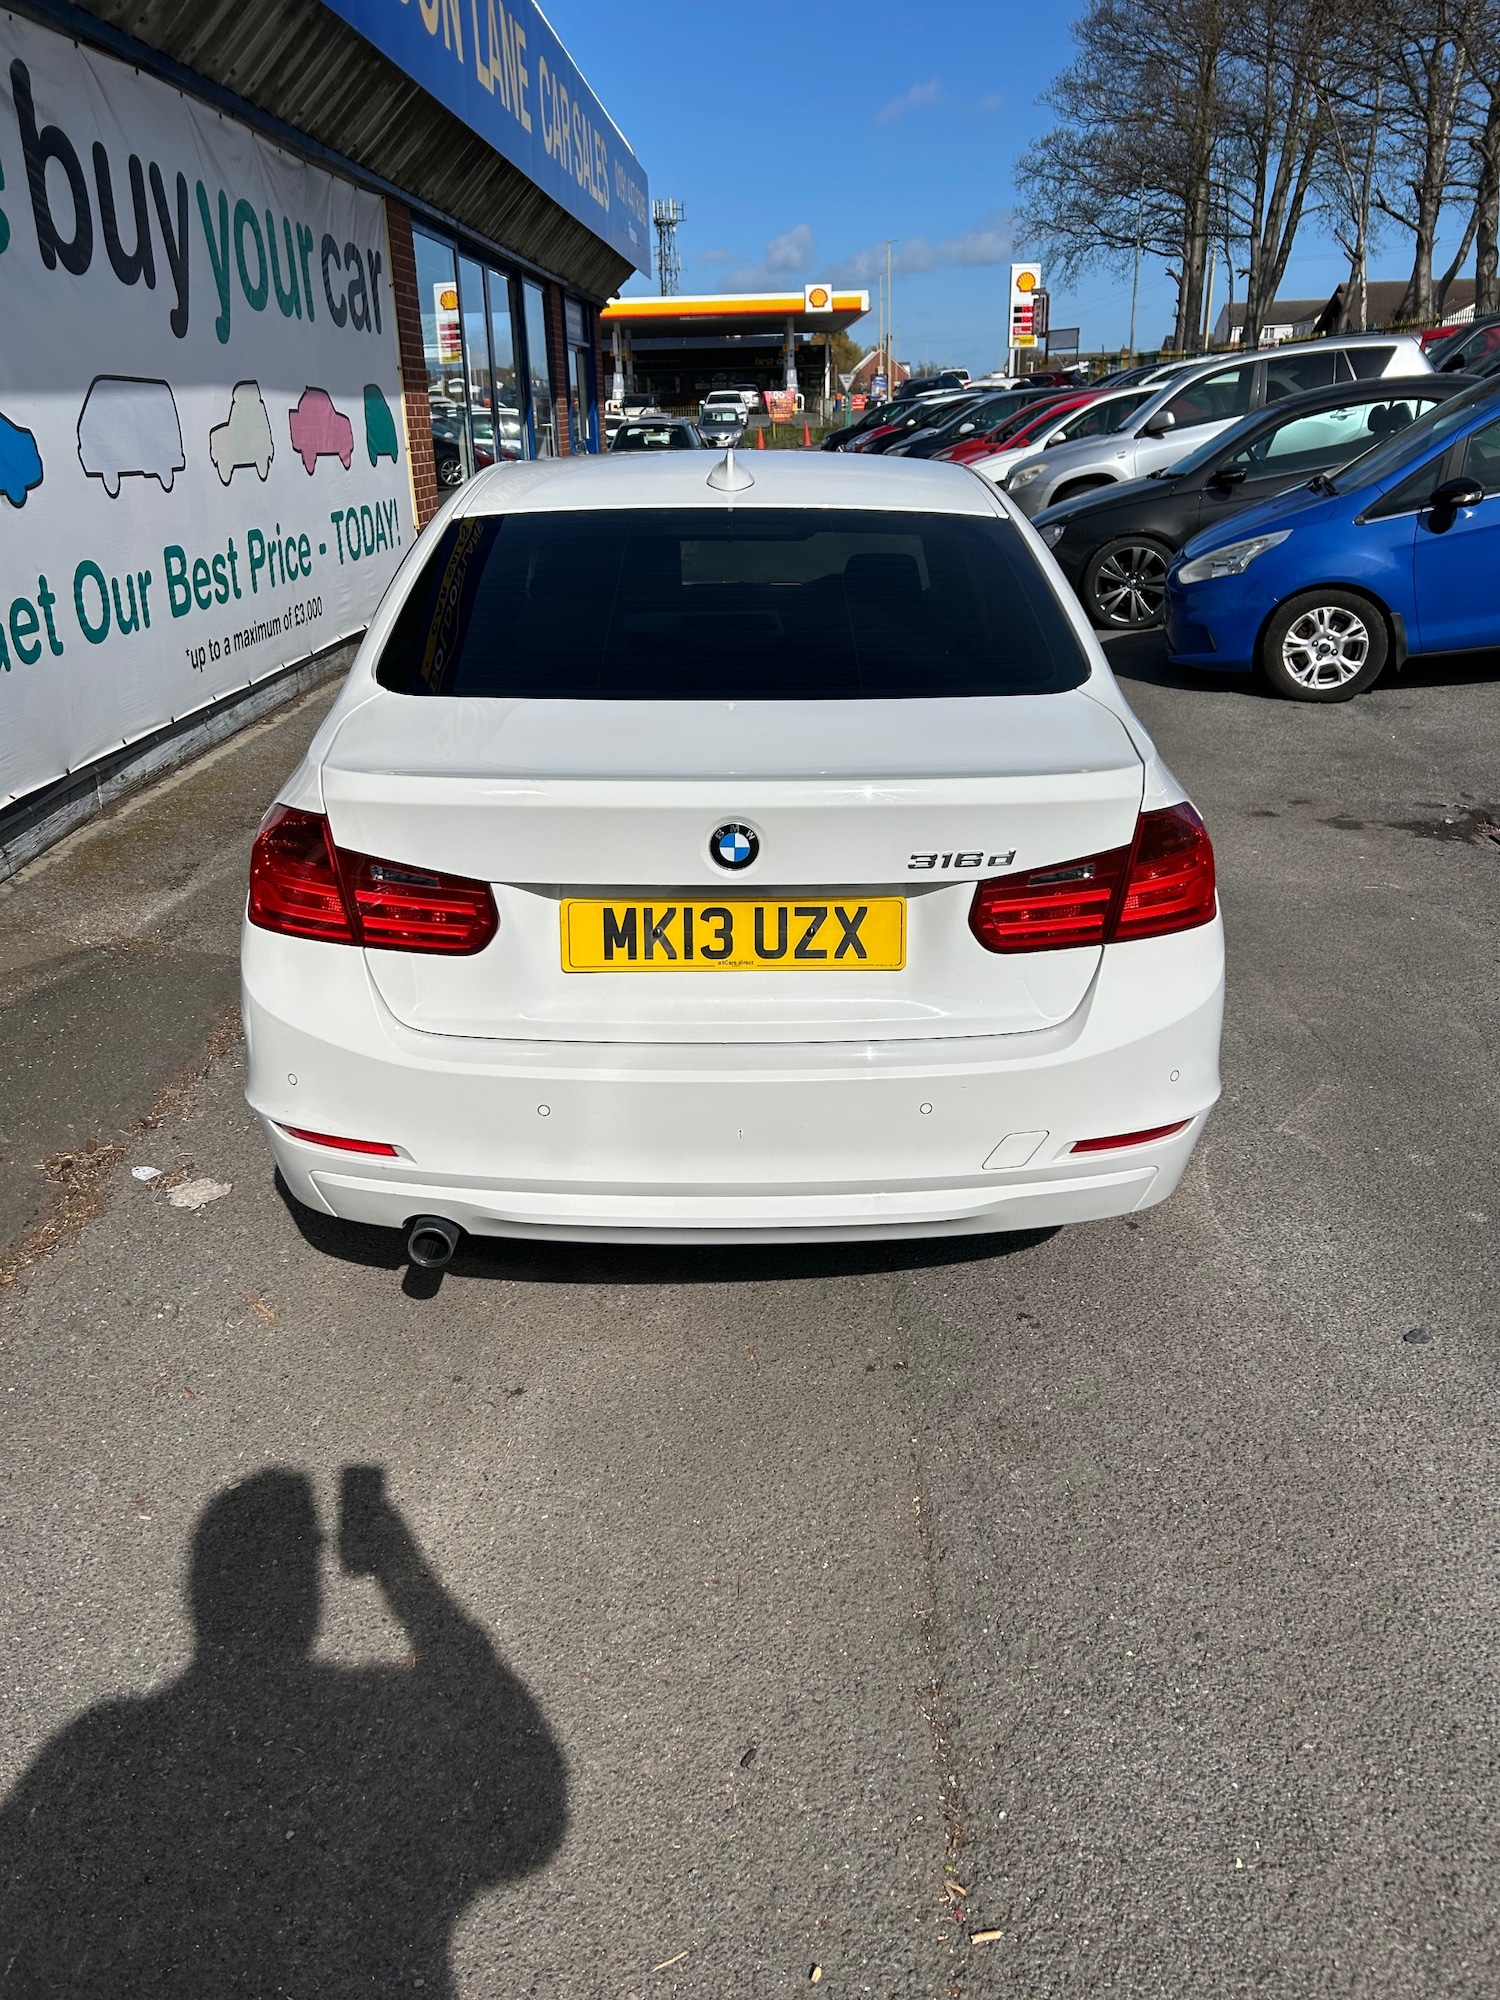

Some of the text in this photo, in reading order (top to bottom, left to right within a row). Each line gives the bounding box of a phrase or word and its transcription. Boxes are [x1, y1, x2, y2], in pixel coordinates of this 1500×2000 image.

[471, 0, 532, 134] LANE
[539, 55, 573, 176] CAR
[572, 100, 610, 213] SALES
[73, 559, 152, 645] Our
[164, 537, 242, 619] Best
[247, 522, 312, 594] Price
[330, 498, 401, 565] TODAY!
[208, 638, 221, 662] to
[224, 637, 231, 656] a
[233, 620, 282, 652] maximum
[283, 606, 293, 631] of
[294, 596, 323, 626] £3,000
[714, 824, 756, 841] BMW
[907, 847, 1017, 870] 316d
[603, 906, 868, 960] MK13 UZX
